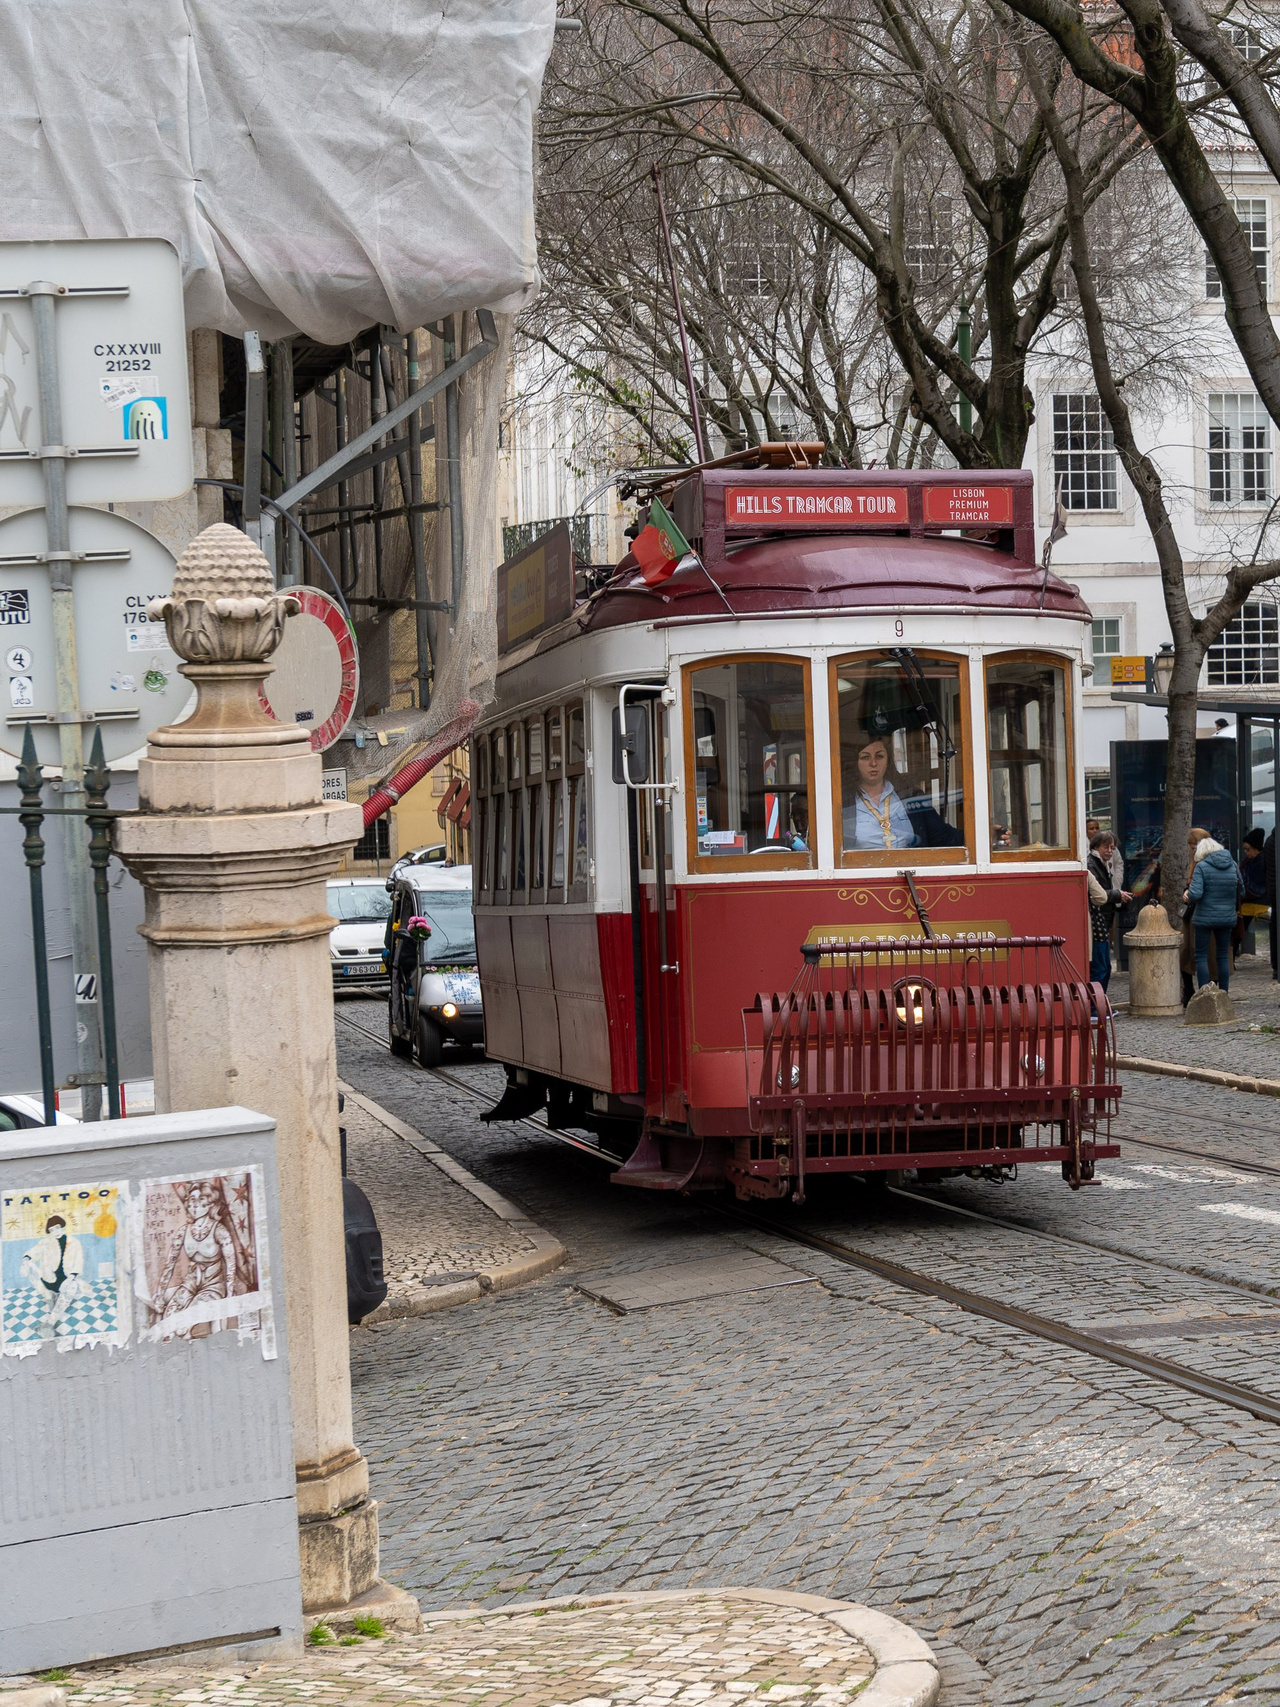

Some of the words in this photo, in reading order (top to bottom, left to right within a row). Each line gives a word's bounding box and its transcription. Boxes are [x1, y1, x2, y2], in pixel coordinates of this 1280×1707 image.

[93, 343, 162, 356] CXXXVIII
[105, 359, 151, 372] 21252
[952, 488, 985, 498] LISBON
[736, 495, 783, 514] HILLS
[786, 495, 853, 514] TRAMCAR
[857, 495, 897, 514] TOUR
[949, 500, 989, 509] PREMIUM
[949, 511, 989, 520] TRAMCAR
[894, 619, 904, 638] 9
[817, 936, 871, 958] HILLS
[956, 931, 998, 954] TOUR
[4, 1189, 110, 1207] TATTOO
